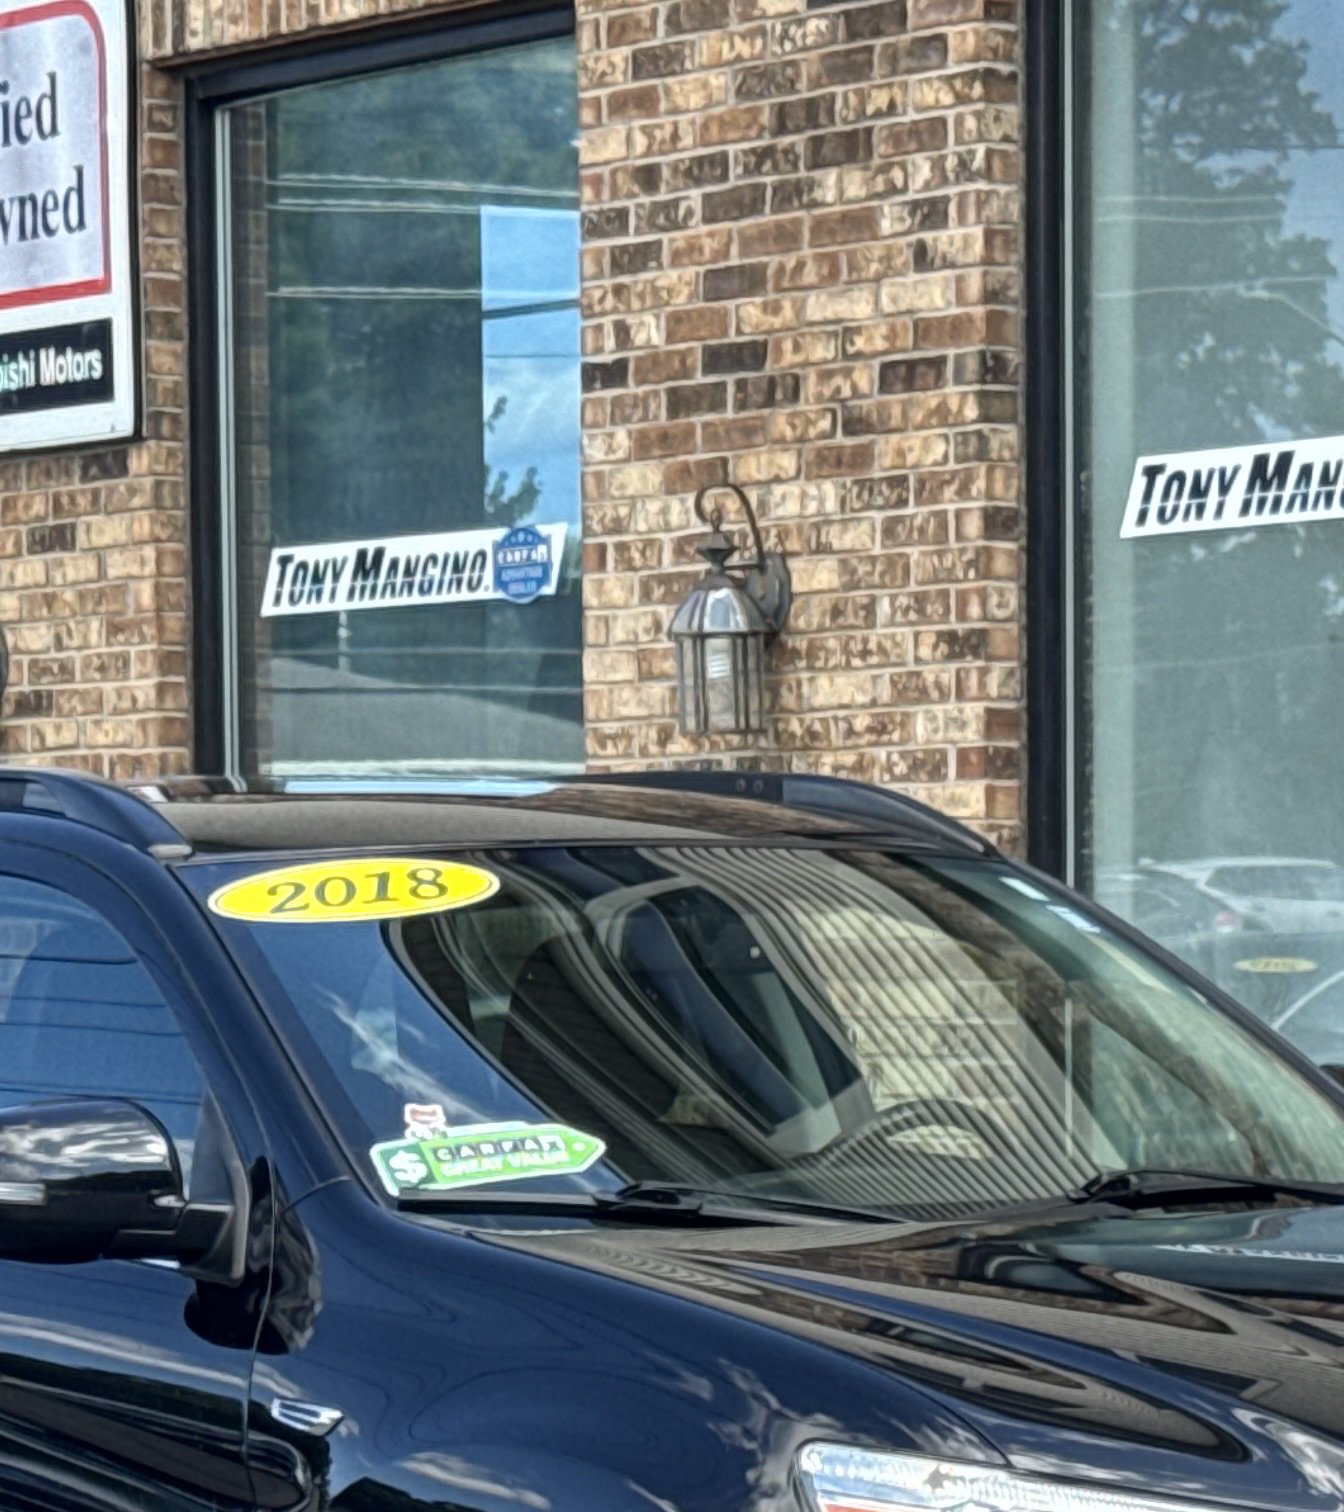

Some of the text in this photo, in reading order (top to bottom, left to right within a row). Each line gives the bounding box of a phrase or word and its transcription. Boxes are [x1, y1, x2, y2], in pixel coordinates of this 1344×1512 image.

[40, 346, 103, 387] Motors
[1134, 463, 1243, 528] TONY
[272, 553, 349, 608] TONY
[267, 867, 449, 914] 2018
